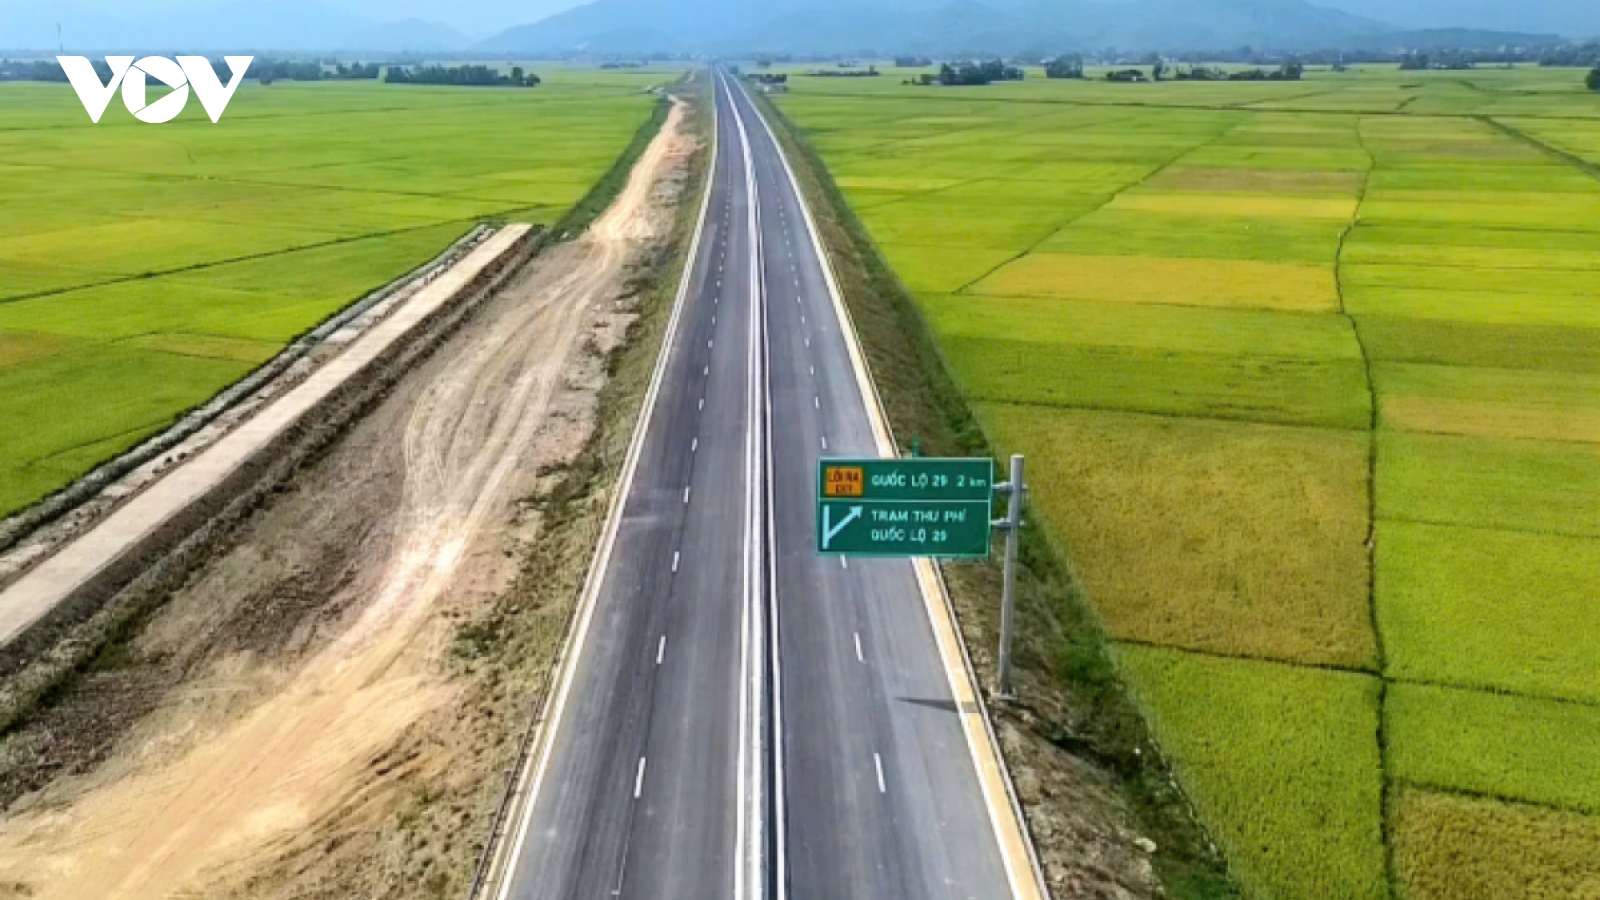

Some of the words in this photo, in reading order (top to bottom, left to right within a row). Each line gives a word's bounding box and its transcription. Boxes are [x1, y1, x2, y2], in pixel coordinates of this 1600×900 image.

[956, 474, 965, 487] 2
[969, 477, 987, 487] km
[911, 509, 940, 523] THU
